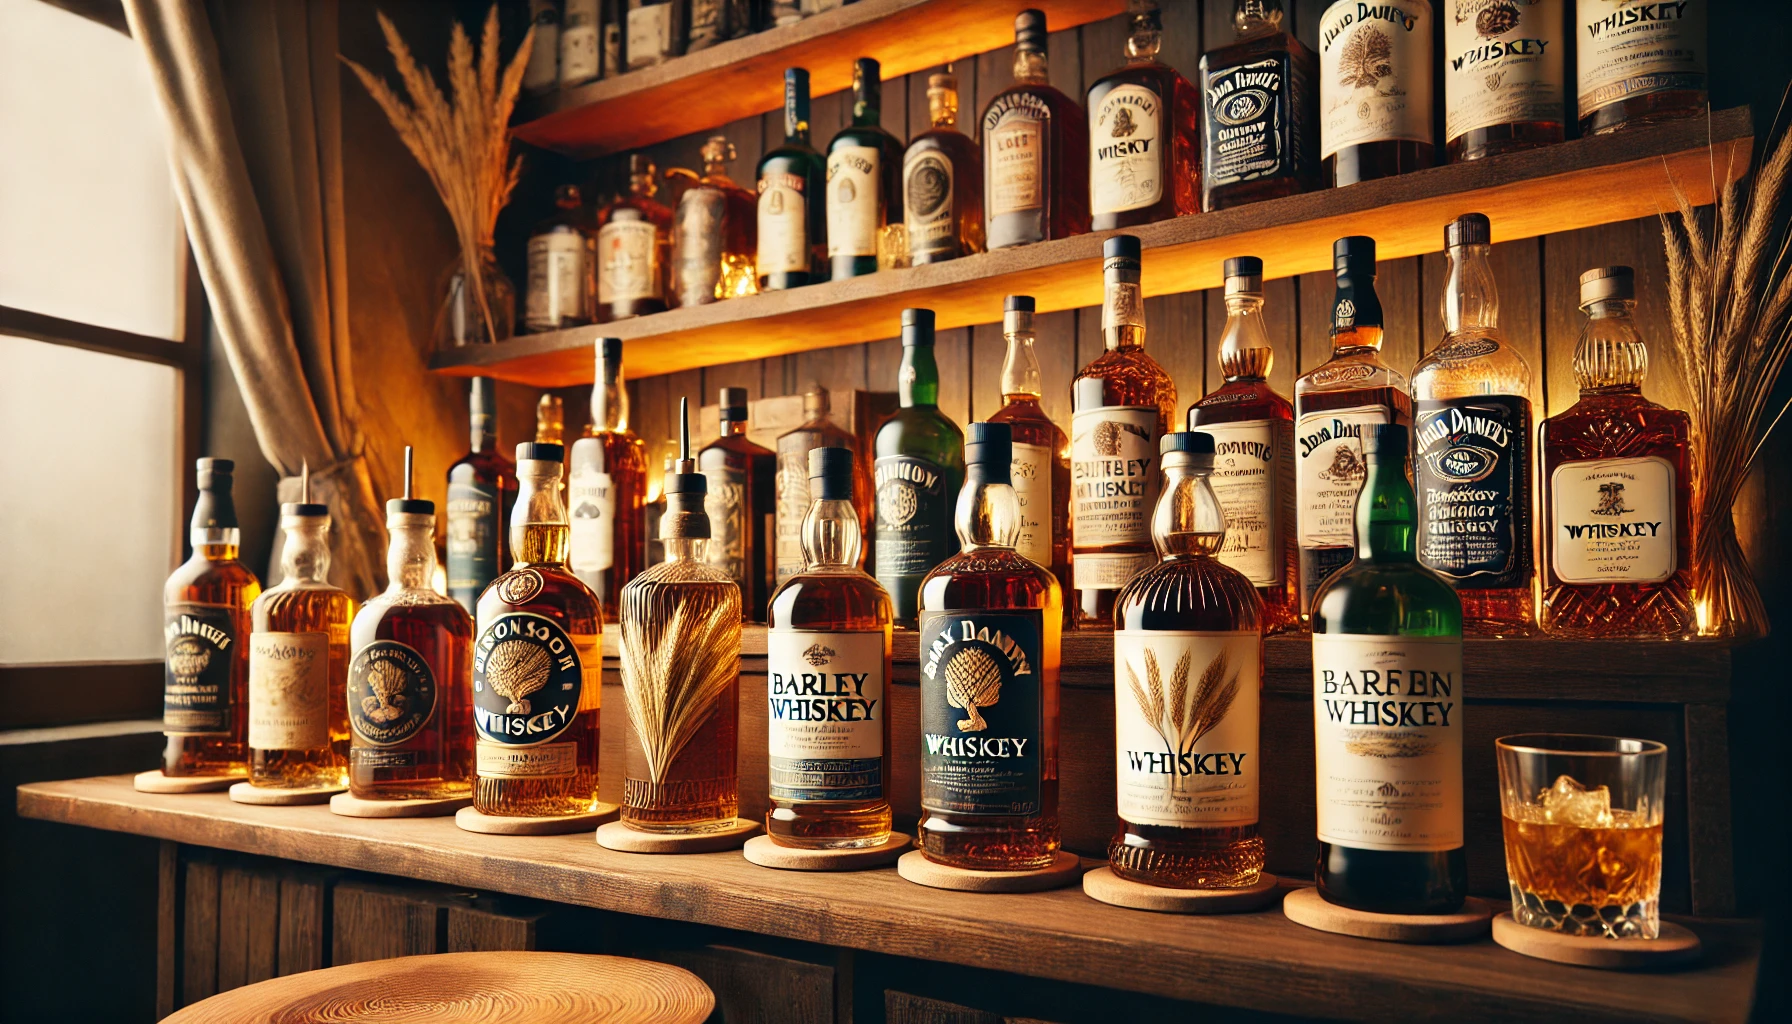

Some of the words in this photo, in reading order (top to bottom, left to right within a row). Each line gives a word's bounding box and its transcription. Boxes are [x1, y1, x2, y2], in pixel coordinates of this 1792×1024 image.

[773, 673, 868, 696] BARLEY
[770, 698, 877, 721] WHISKEY
[1324, 699, 1453, 727] WHISKEY
[925, 734, 1028, 757] WHISKEY
[1127, 750, 1247, 776] WHISKEY
